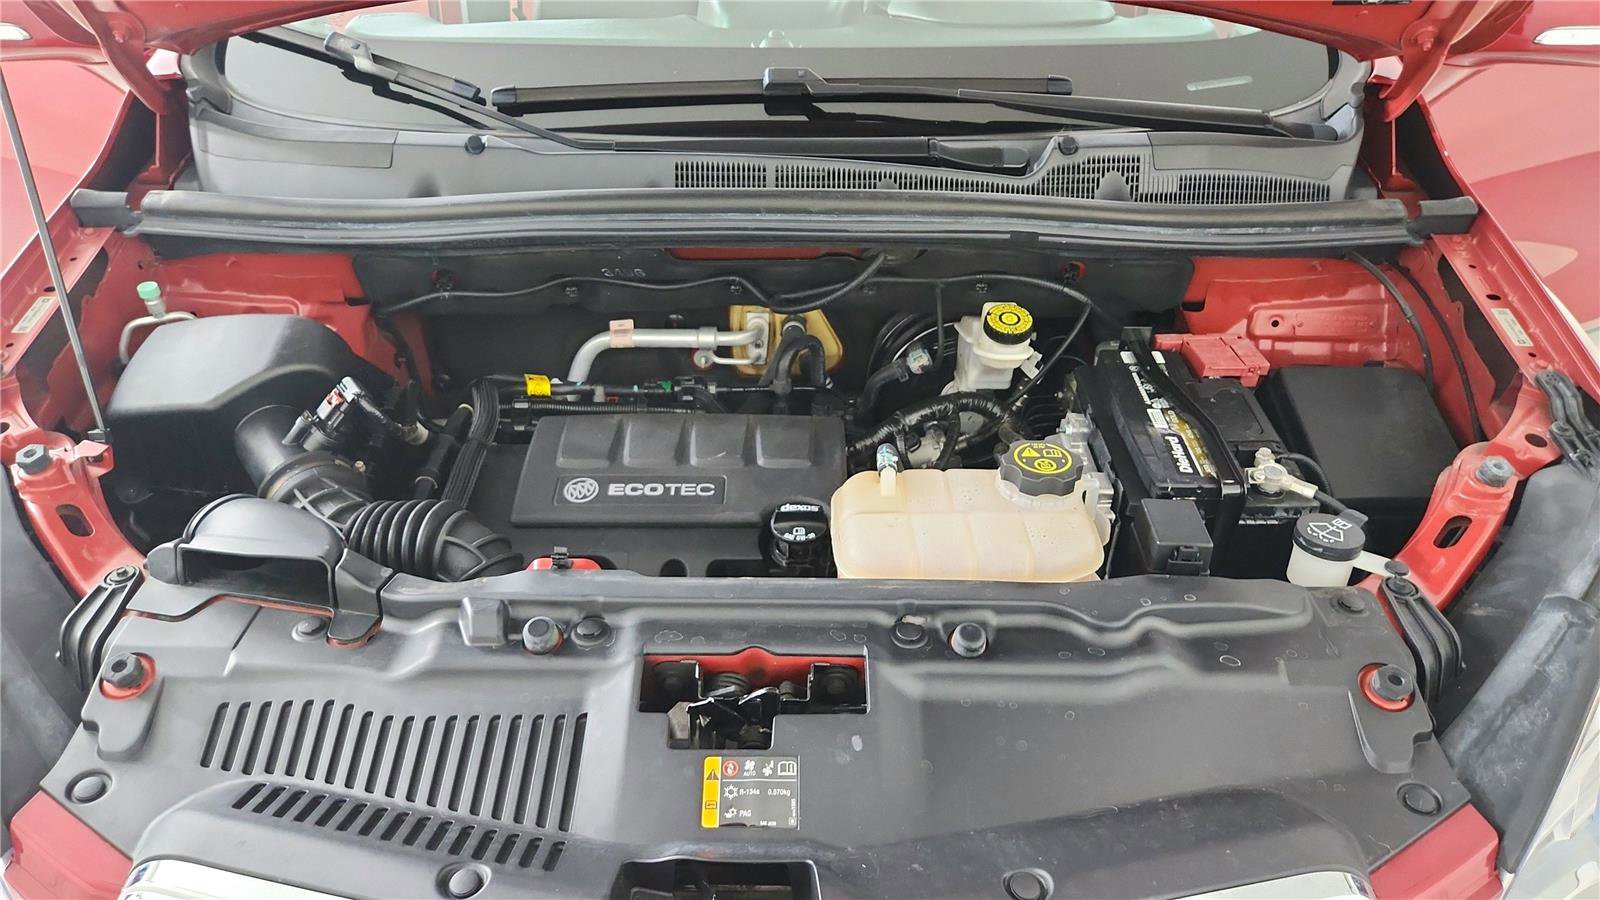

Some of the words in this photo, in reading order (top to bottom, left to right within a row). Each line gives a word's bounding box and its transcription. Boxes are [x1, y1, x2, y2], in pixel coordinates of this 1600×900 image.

[1165, 435, 1194, 474] DieHard
[607, 483, 715, 496] ECOTEC
[780, 503, 820, 512] dexos
[739, 788, 760, 796] R-134a
